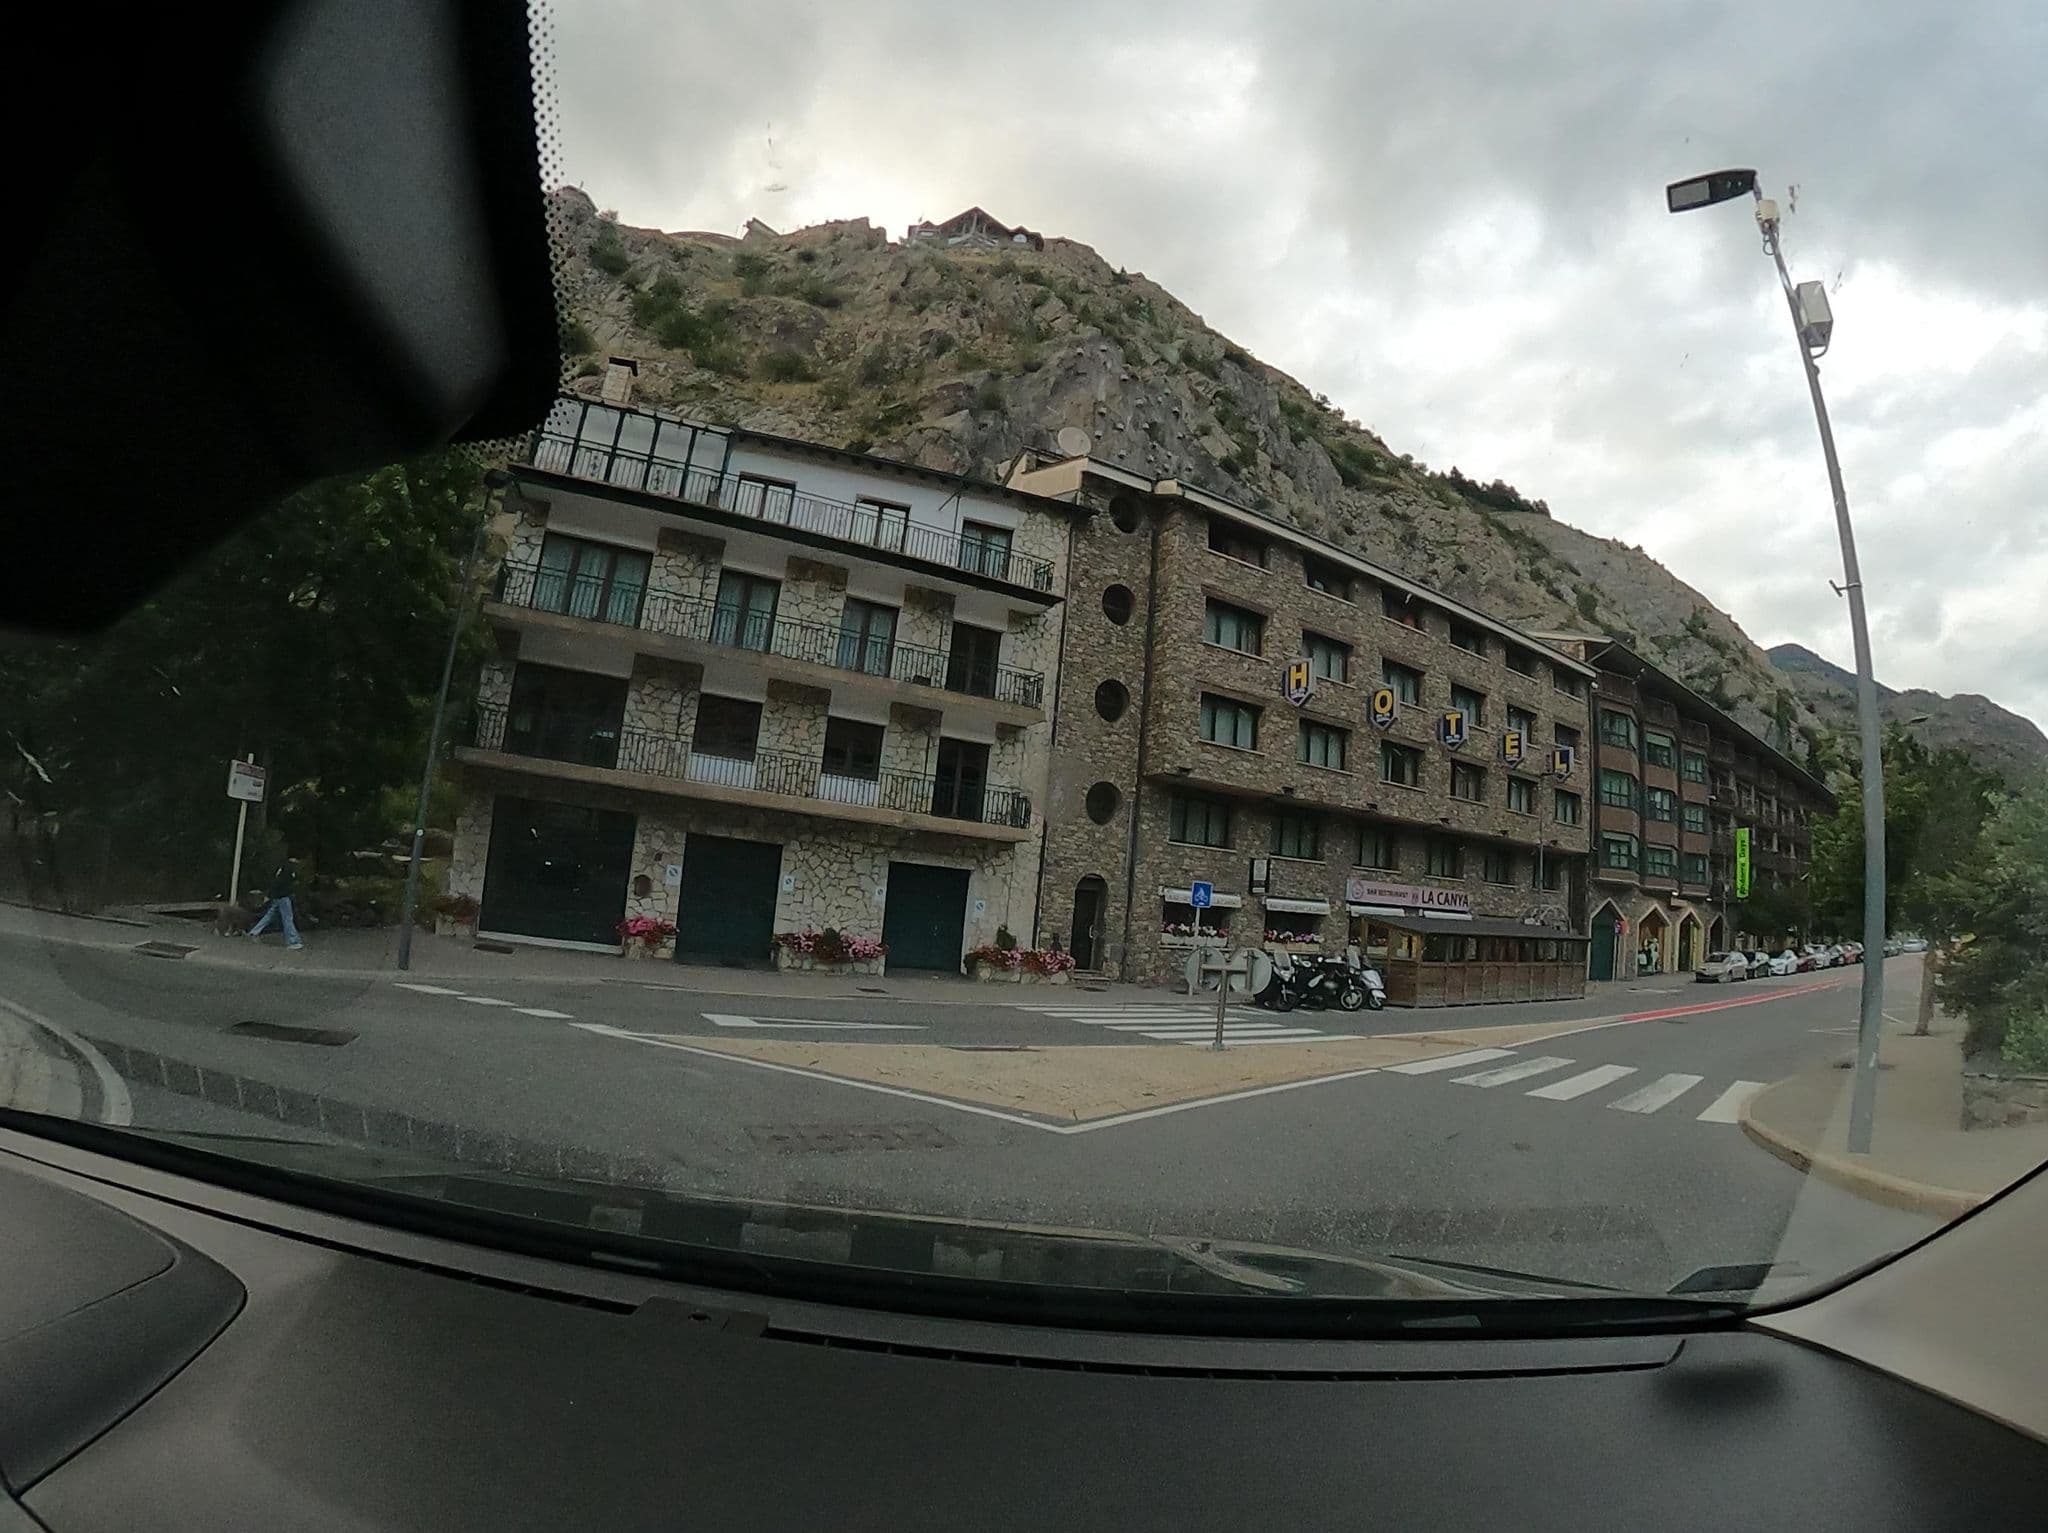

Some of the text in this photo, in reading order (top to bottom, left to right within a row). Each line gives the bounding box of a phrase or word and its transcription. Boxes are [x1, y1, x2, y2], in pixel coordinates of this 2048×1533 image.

[1290, 662, 1568, 770] HOTEL
[1422, 890, 1434, 905] LA
[1437, 892, 1469, 907] CANYA
